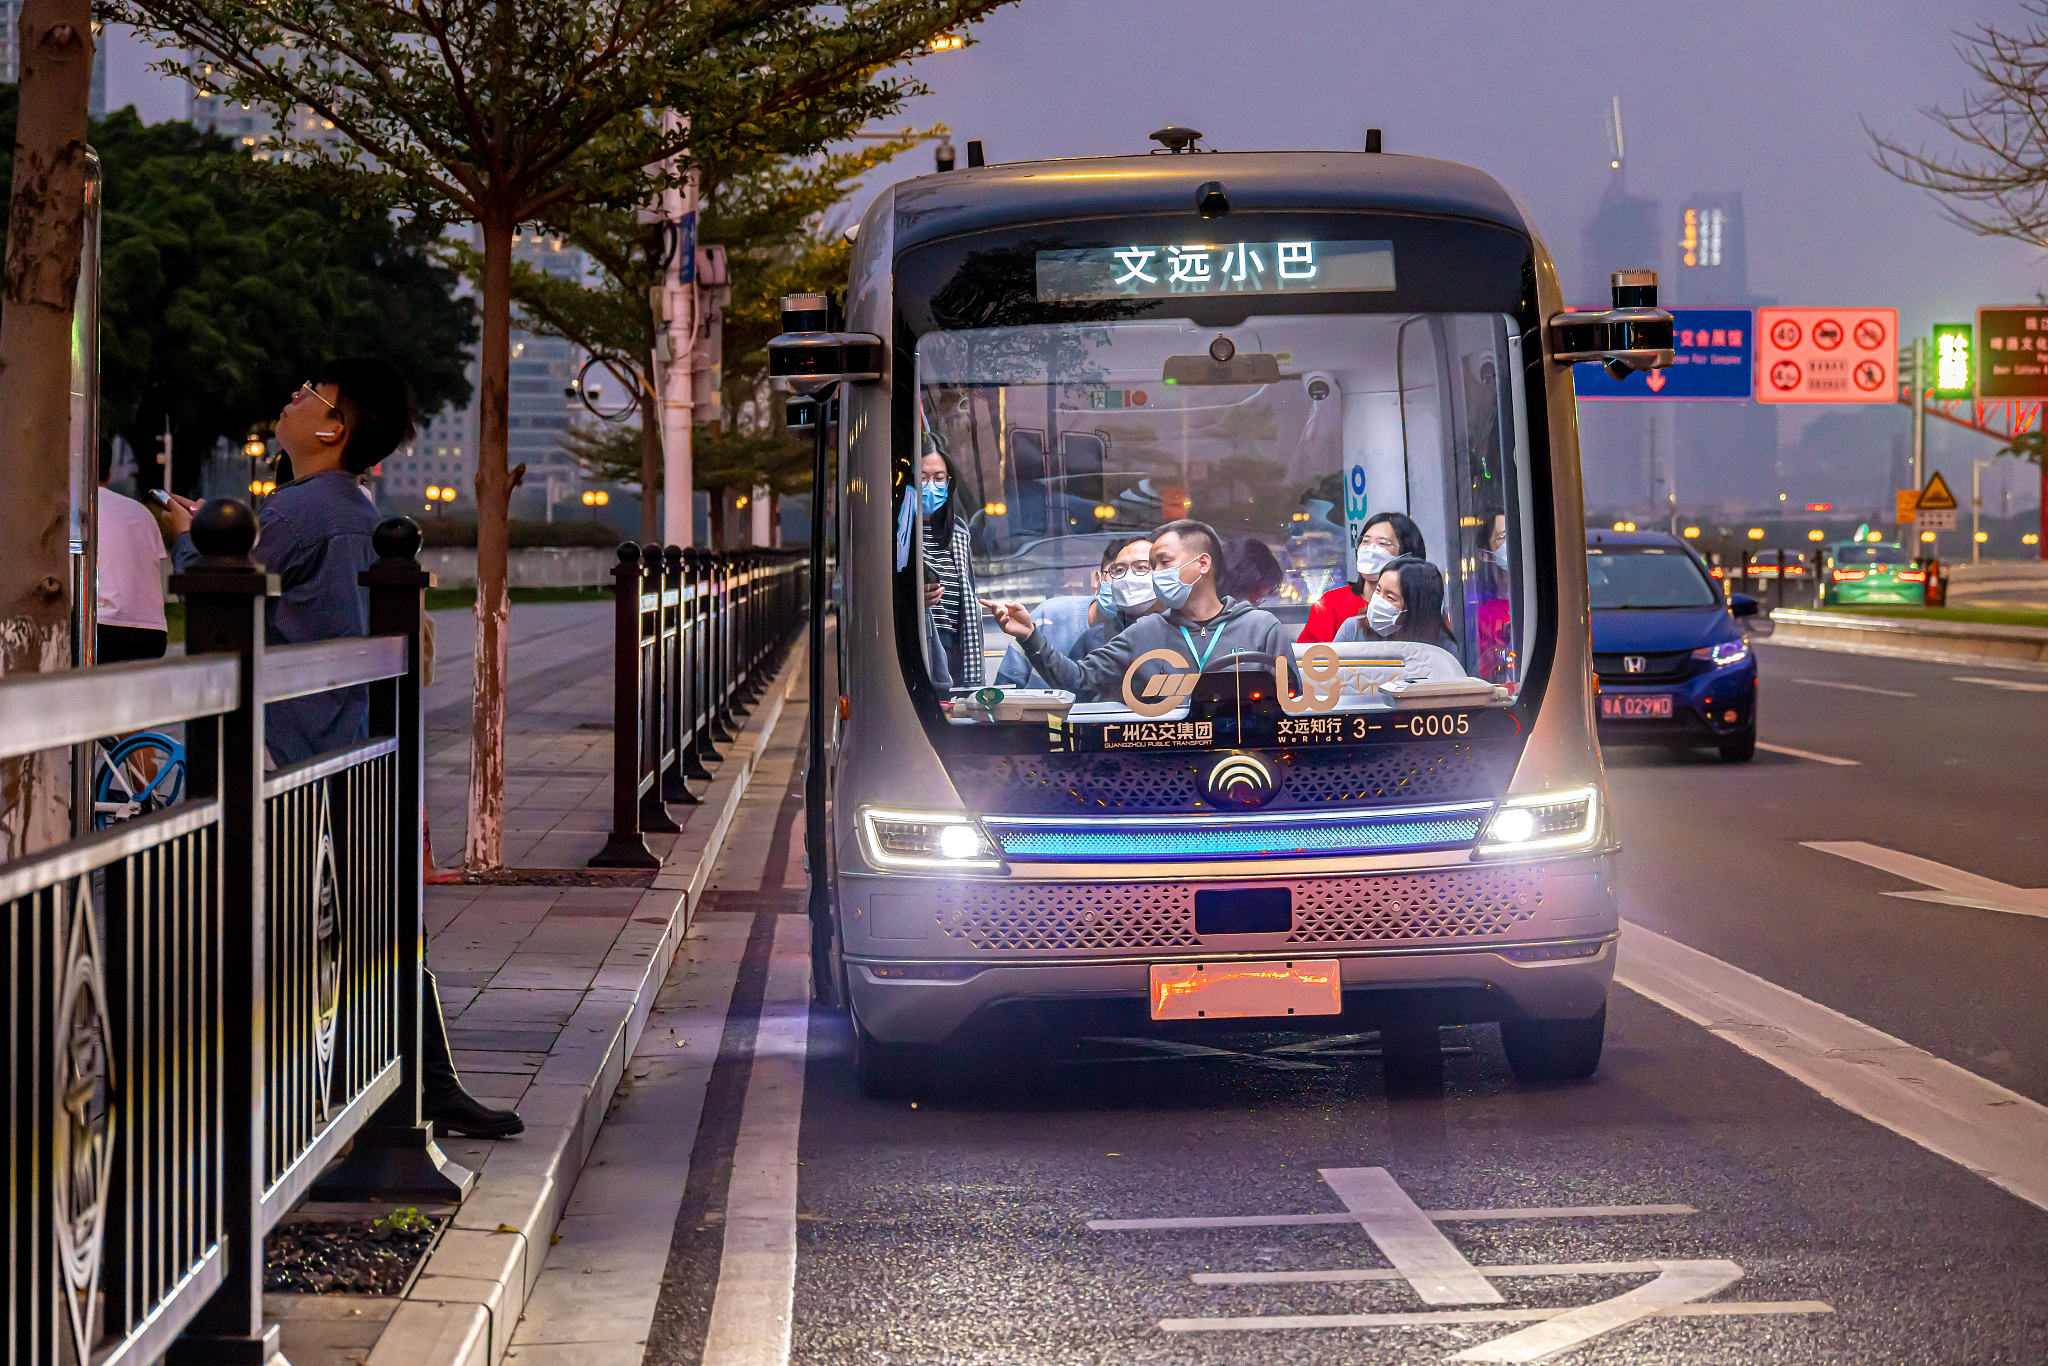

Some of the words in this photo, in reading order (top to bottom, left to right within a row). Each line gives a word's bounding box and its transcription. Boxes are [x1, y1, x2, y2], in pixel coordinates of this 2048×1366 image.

[1114, 242, 1317, 285] 文远小巴
[1103, 721, 1213, 742] 广州公交集团
[1277, 717, 1342, 734] 文远知行
[1104, 741, 1146, 749] GUANGZHOU
[1277, 735, 1343, 743] WeRide
